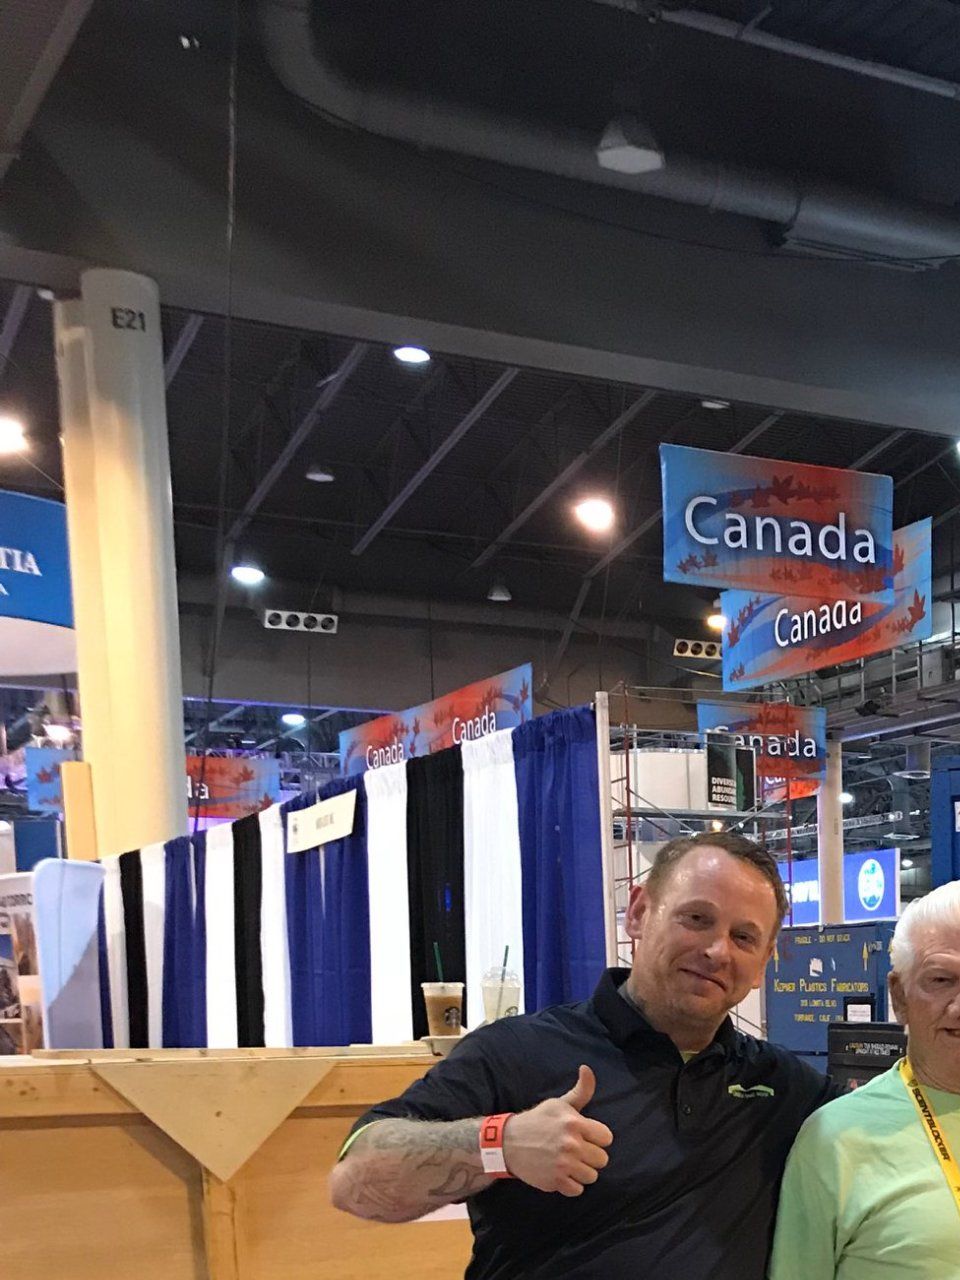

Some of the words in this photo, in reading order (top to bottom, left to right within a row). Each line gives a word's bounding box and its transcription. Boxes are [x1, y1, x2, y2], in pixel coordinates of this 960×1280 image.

[111, 307, 146, 332] E21
[684, 495, 876, 564] Canada
[774, 599, 862, 648] Canada
[452, 705, 497, 744] Canada
[714, 725, 817, 758] anada
[366, 736, 405, 770] Canada
[799, 978, 828, 992] PLASTICS
[831, 978, 869, 992] FABRICATORS
[912, 1087, 951, 1163] SCENTBLOCKER
